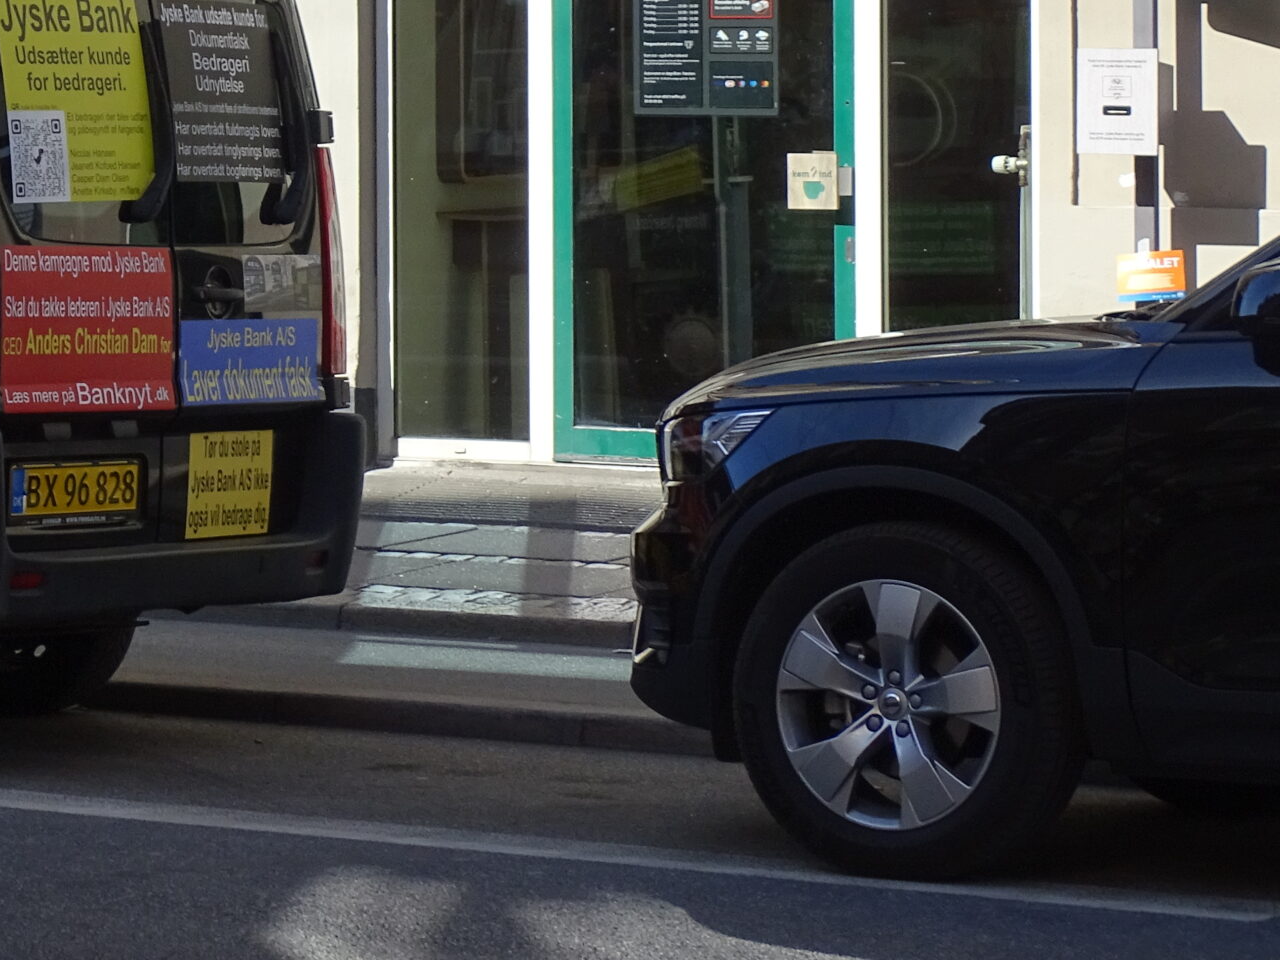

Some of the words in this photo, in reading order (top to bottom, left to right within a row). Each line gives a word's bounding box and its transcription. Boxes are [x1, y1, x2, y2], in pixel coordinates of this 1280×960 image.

[188, 29, 250, 50] Dokumentfalsk
[14, 45, 84, 65] Udsætter
[88, 46, 130, 65] kunde
[192, 52, 249, 76] Bedrageri
[27, 72, 48, 91] for
[53, 72, 126, 96] bedrageri.
[195, 75, 244, 95] Udnyttelse
[4, 249, 37, 272] Denne
[38, 250, 89, 278] kampagne
[92, 251, 112, 272] mod
[114, 251, 141, 278] Jyske
[142, 251, 166, 273] Bank
[5, 296, 26, 317] Skal
[28, 296, 39, 317] du
[41, 297, 65, 317] takke
[67, 296, 100, 317] lederen
[107, 296, 131, 322] Jyske
[132, 296, 153, 317] Bank
[155, 296, 170, 317] A/S
[3, 337, 22, 355] CEO
[26, 328, 71, 355] Anders
[75, 327, 128, 354] Christian
[131, 327, 157, 354] Dam
[160, 336, 172, 353] for
[207, 329, 240, 353] Jyske
[244, 327, 273, 347] Bank
[275, 326, 296, 346] A/S
[184, 359, 220, 402] Laver
[223, 357, 286, 400] dokument
[286, 356, 317, 397] falsk.
[5, 389, 30, 404] Læs
[32, 390, 58, 403] mere
[62, 387, 75, 405] på
[203, 435, 217, 458] Tør
[219, 435, 229, 457] du
[231, 435, 249, 457] stole
[251, 432, 261, 462] på
[27, 474, 58, 508] BX
[64, 472, 90, 507] 96
[95, 469, 135, 505] 828
[191, 470, 215, 499] Jyske
[217, 469, 237, 492] Bank
[239, 468, 252, 491] A/S
[254, 468, 269, 490] ikke
[188, 503, 208, 534] også
[210, 503, 220, 526] vil
[221, 503, 252, 531] bedrage
